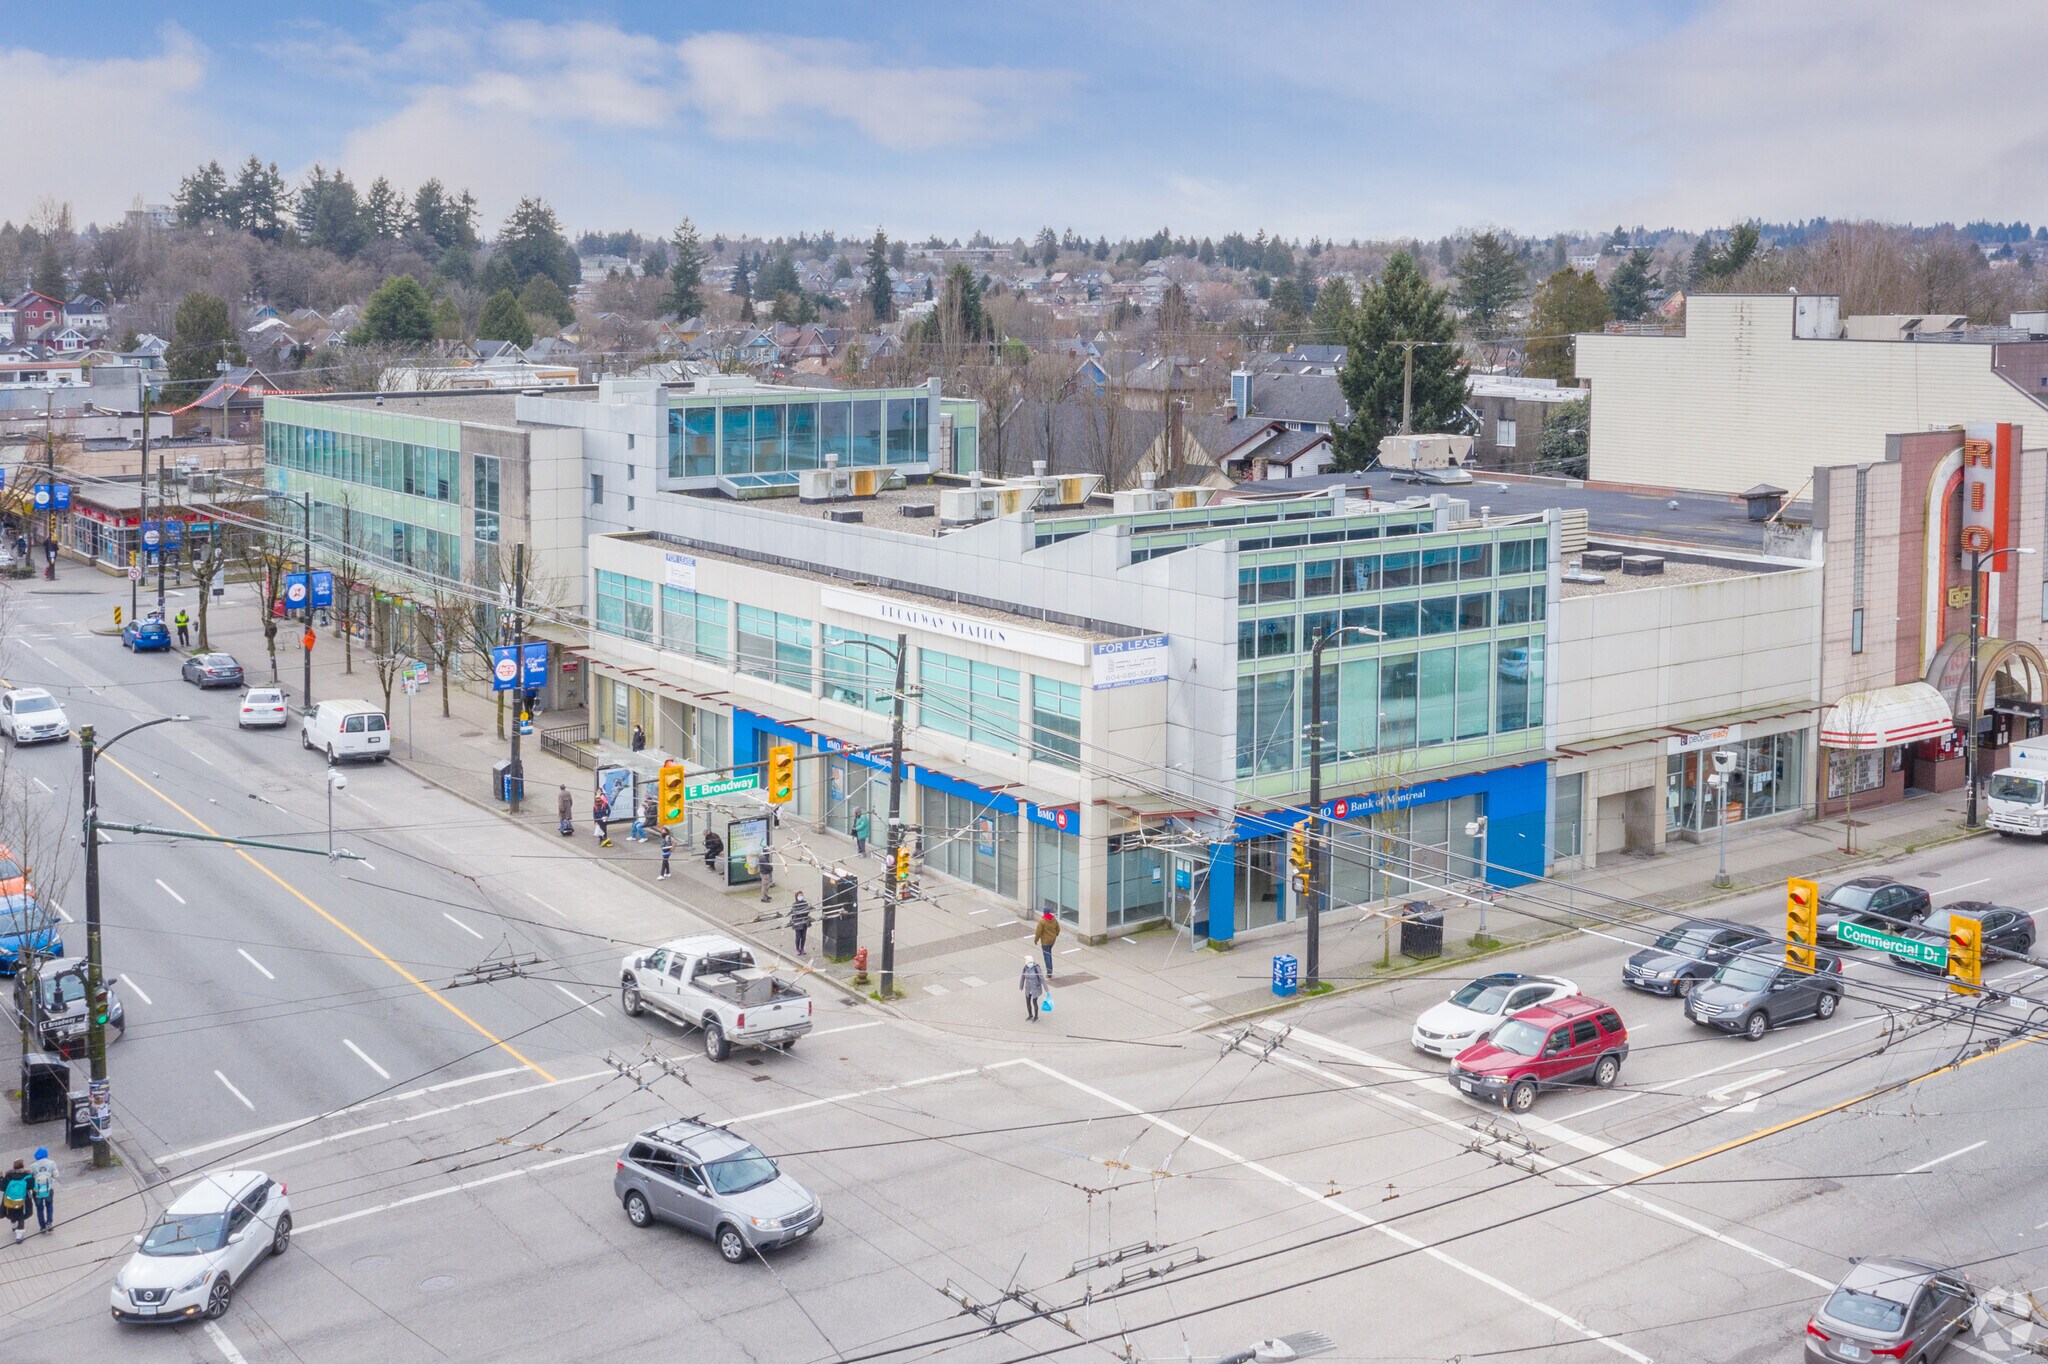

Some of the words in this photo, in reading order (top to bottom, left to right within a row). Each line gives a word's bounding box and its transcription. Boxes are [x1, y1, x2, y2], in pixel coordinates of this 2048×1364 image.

[1961, 439, 1992, 554] RIO
[952, 621, 1006, 641] STATION
[1099, 643, 1123, 653] FOR
[1128, 637, 1163, 650] LEASE
[826, 740, 841, 751] BMO
[1688, 729, 1729, 744] peopleready
[689, 786, 697, 797] E
[702, 778, 753, 795] Broadway
[1351, 799, 1374, 812] Bank
[1375, 796, 1384, 806] of
[1387, 788, 1426, 804] Montreal
[1037, 808, 1055, 822] BMO
[1843, 925, 1919, 957] Commercial
[1923, 946, 1940, 962] Dr
